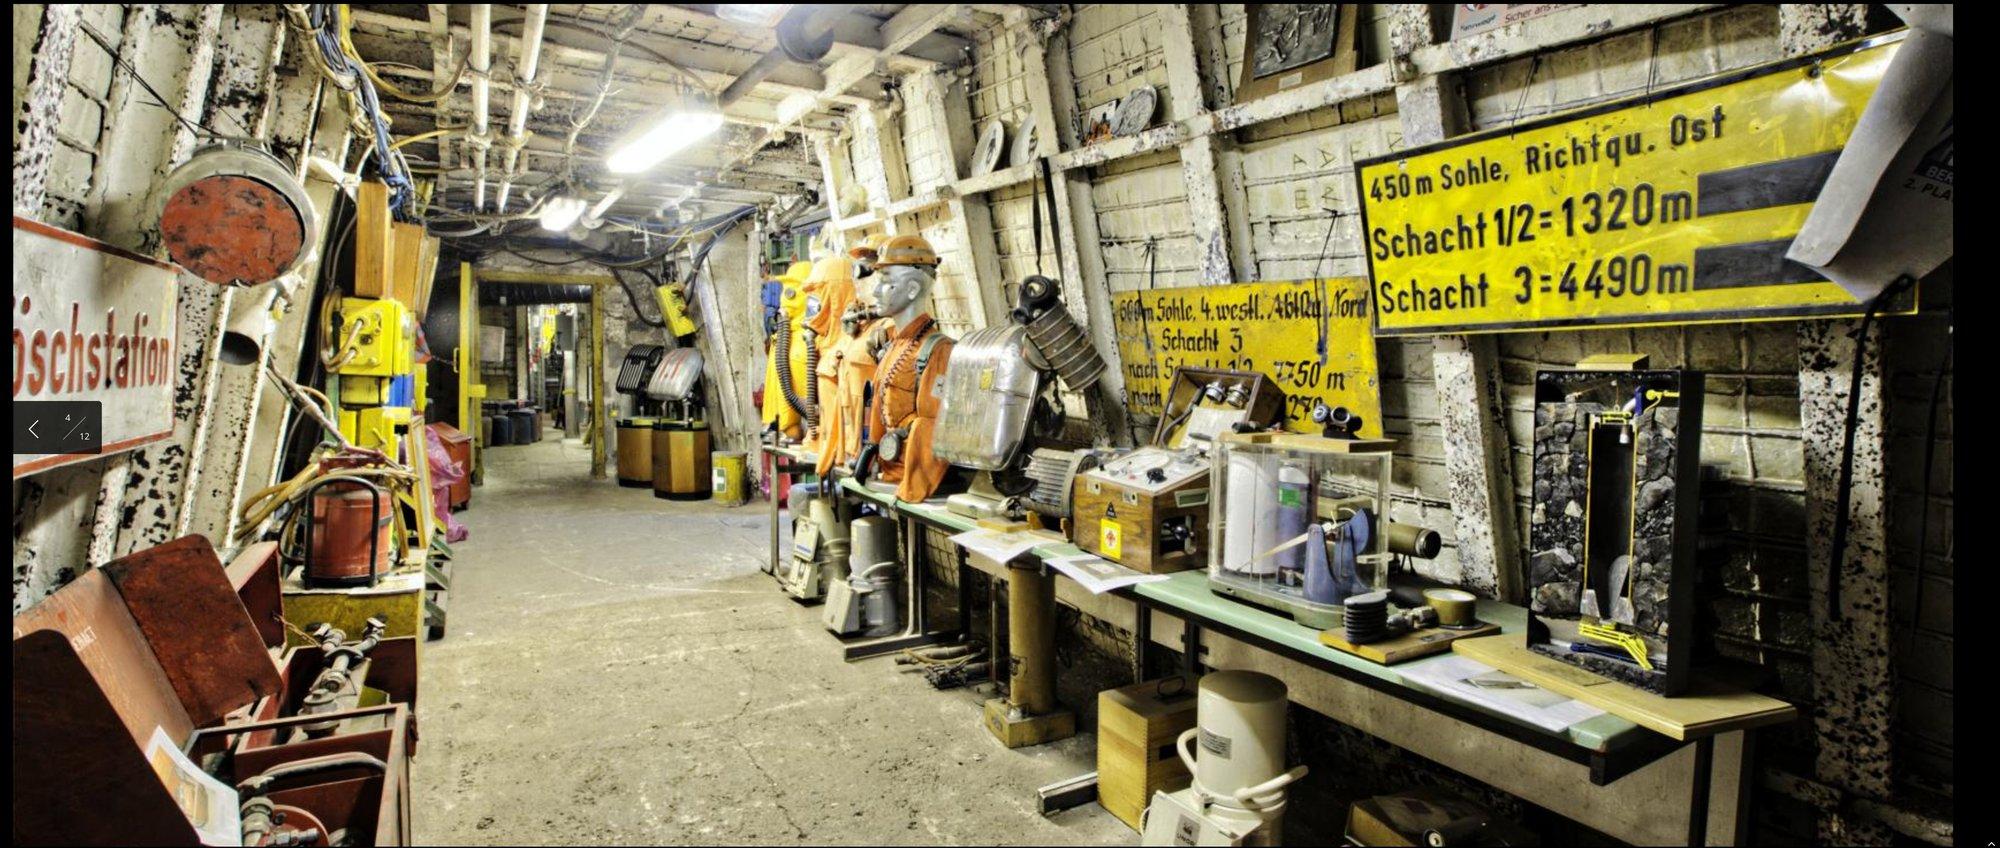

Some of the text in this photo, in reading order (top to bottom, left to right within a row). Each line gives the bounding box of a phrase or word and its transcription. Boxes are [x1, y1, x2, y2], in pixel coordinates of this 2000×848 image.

[1505, 9, 1531, 23] Sicher
[1440, 156, 1510, 190] Sohle,
[1525, 132, 1657, 176] Richtqu.
[1670, 105, 1726, 147] Ost
[1373, 212, 1488, 261] Schacht
[1328, 288, 1369, 318] Nord
[1380, 273, 1489, 314] Schacht
[1162, 327, 1243, 352] Schacht 3
[1128, 358, 1159, 380] nach
[1326, 373, 1345, 391] m
[1132, 387, 1162, 407] nach
